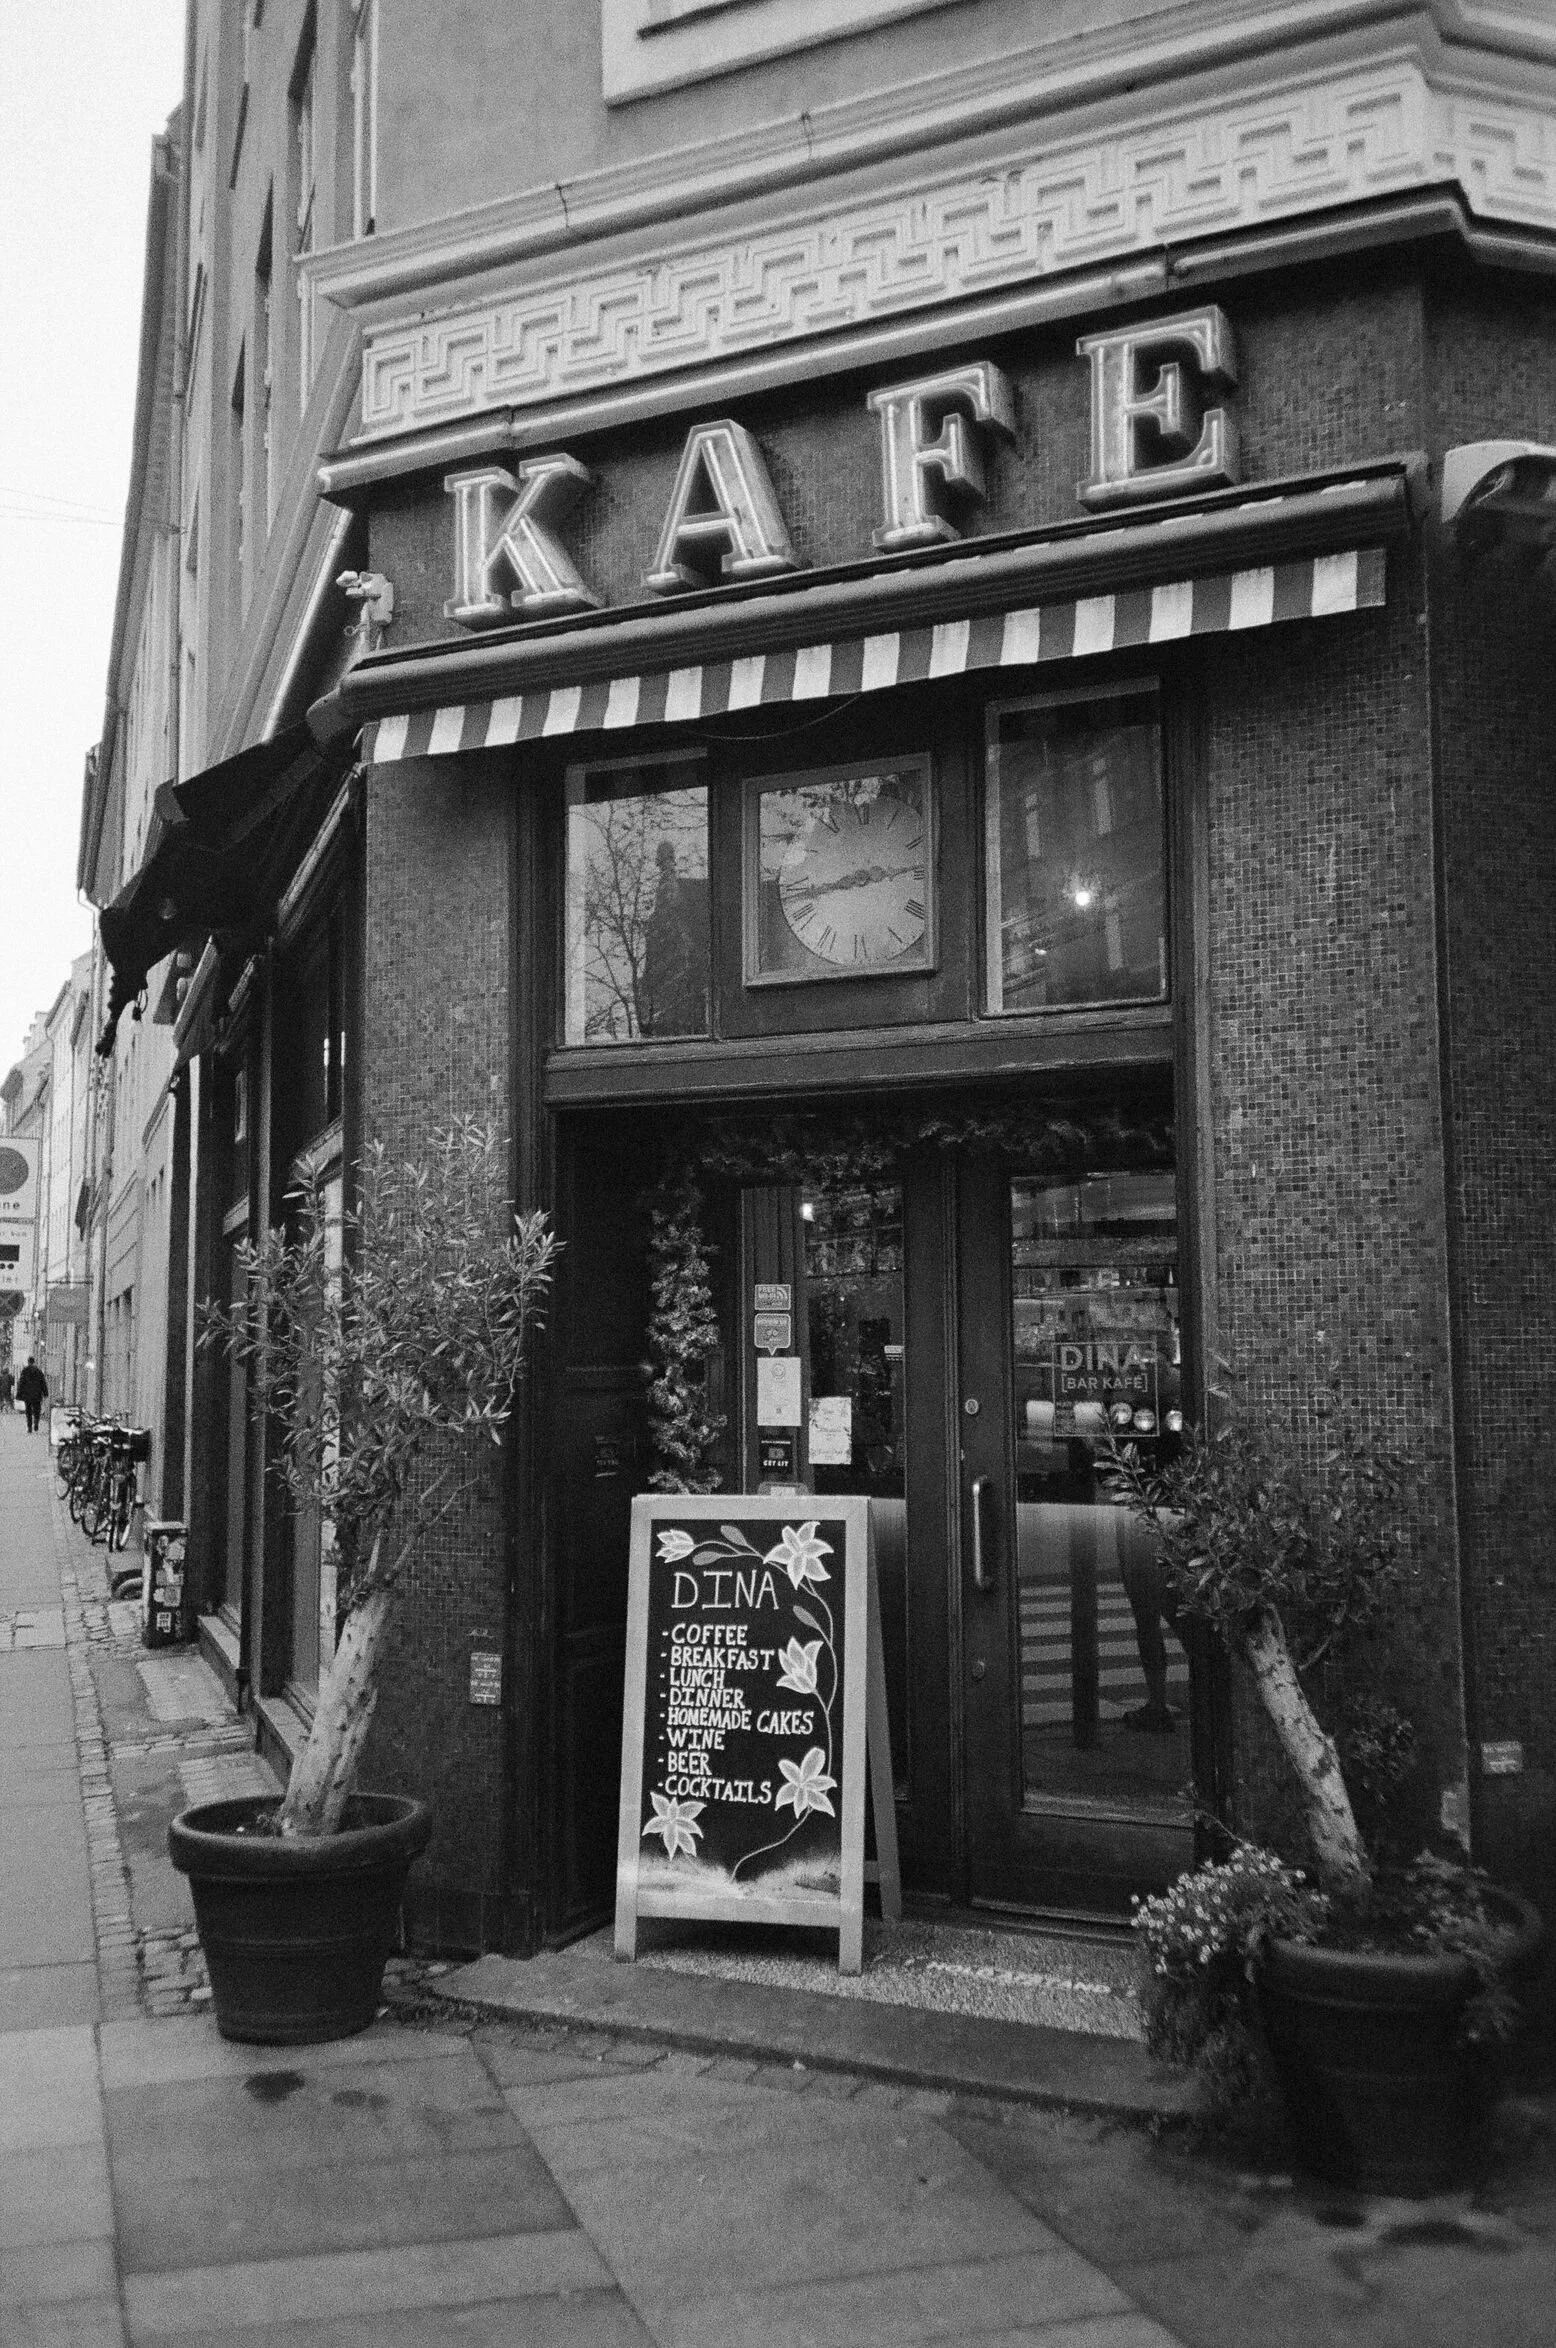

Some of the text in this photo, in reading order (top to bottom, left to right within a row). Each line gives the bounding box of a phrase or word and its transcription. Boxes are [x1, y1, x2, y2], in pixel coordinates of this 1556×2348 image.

[444, 305, 1241, 627] KAFE
[1060, 1344, 1147, 1371] DINA
[671, 1569, 779, 1610] DINA
[671, 1623, 748, 1646] COFFEE
[670, 1645, 775, 1670] BREAKFAST
[670, 1667, 725, 1689] LUNCH
[669, 1687, 745, 1709] DINNER
[667, 1706, 814, 1735] HOMEMADE CAKES
[666, 1727, 726, 1751] WINE
[667, 1750, 712, 1776] BEER
[664, 1775, 772, 1804] COCKTAILS
